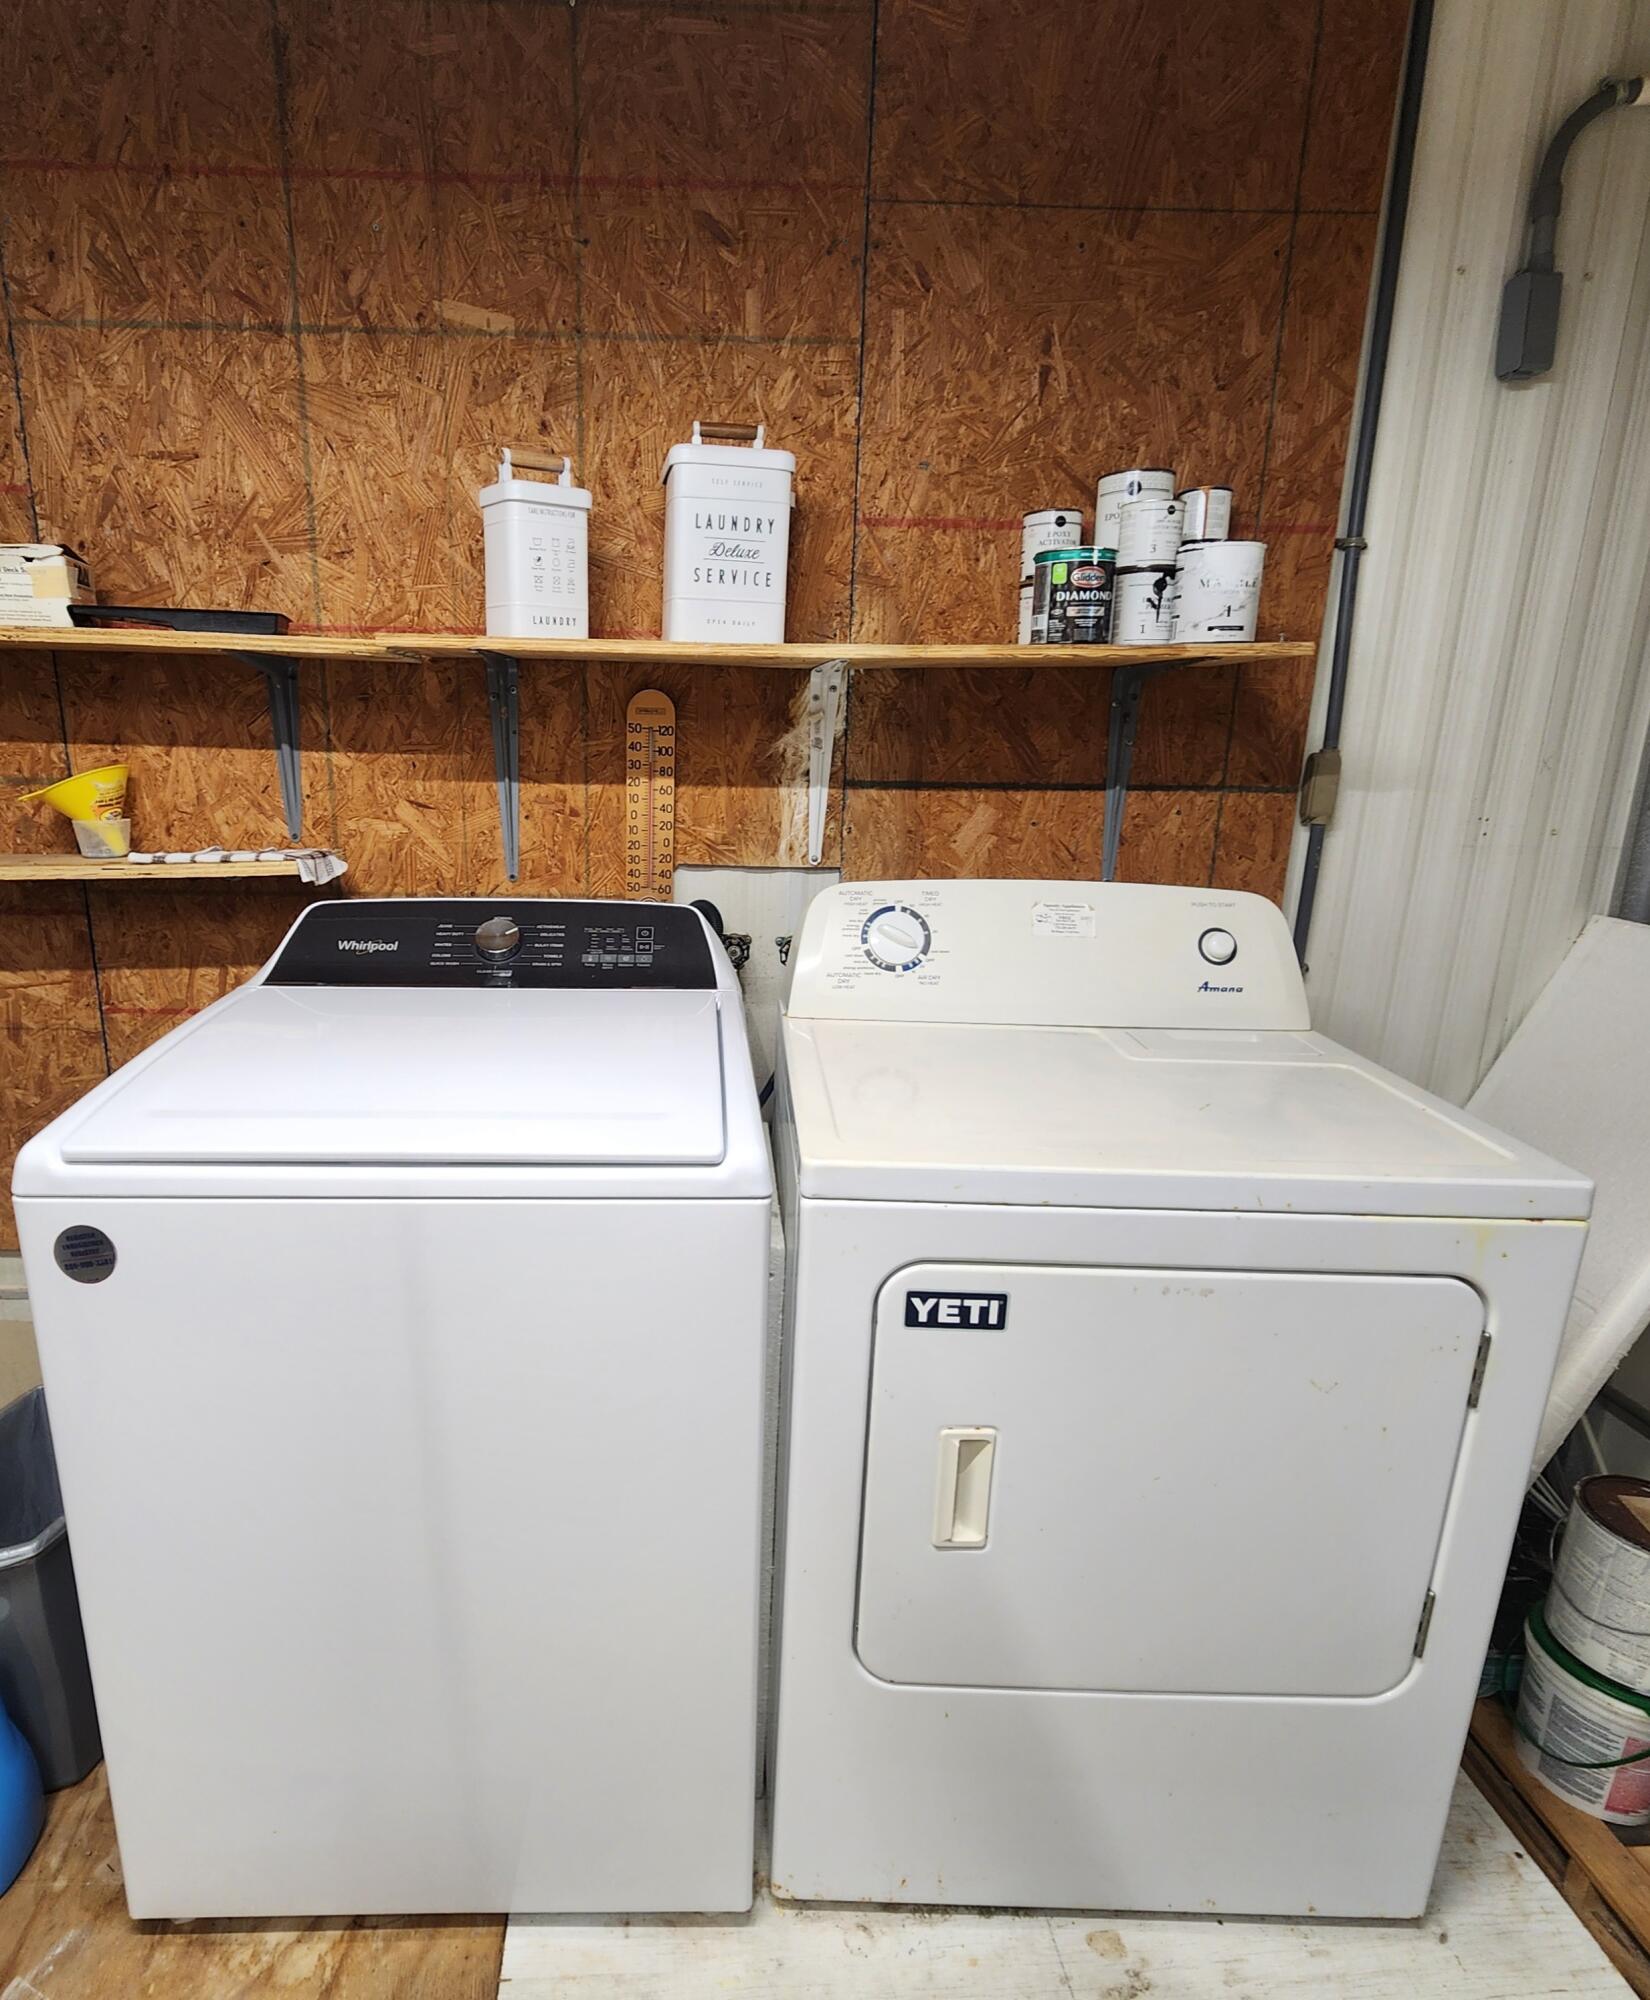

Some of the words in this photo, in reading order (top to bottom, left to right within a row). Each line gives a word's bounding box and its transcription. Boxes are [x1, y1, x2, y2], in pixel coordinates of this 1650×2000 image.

[695, 513, 775, 534] LAUNDRY
[709, 542, 760, 560] Deluxe
[694, 567, 772, 588] SERVICE
[1073, 572, 1105, 582] Glidden
[1056, 591, 1112, 601] DIAMOND
[533, 616, 576, 626] LAUNDRY
[628, 723, 642, 733] 50
[658, 726, 674, 736] 120
[628, 742, 642, 752] 40
[658, 746, 673, 756] 100
[628, 760, 641, 769] 30
[659, 767, 673, 776] 80
[628, 777, 640, 786] 20
[659, 786, 672, 795] 60
[629, 794, 639, 803] 10
[660, 804, 672, 813] 40
[631, 810, 638, 820] 0
[629, 825, 638, 834] 10
[659, 821, 672, 830] 20
[628, 840, 640, 850] 20
[664, 838, 670, 848] 0
[628, 855, 640, 864] 30
[659, 854, 672, 863] 20
[628, 868, 640, 878] 40
[658, 869, 672, 879] 40
[627, 882, 640, 892] 50
[658, 885, 671, 894] 60
[338, 940, 399, 953] Whirlpool
[1197, 981, 1244, 992] Amana
[910, 1297, 999, 1325] YETI
